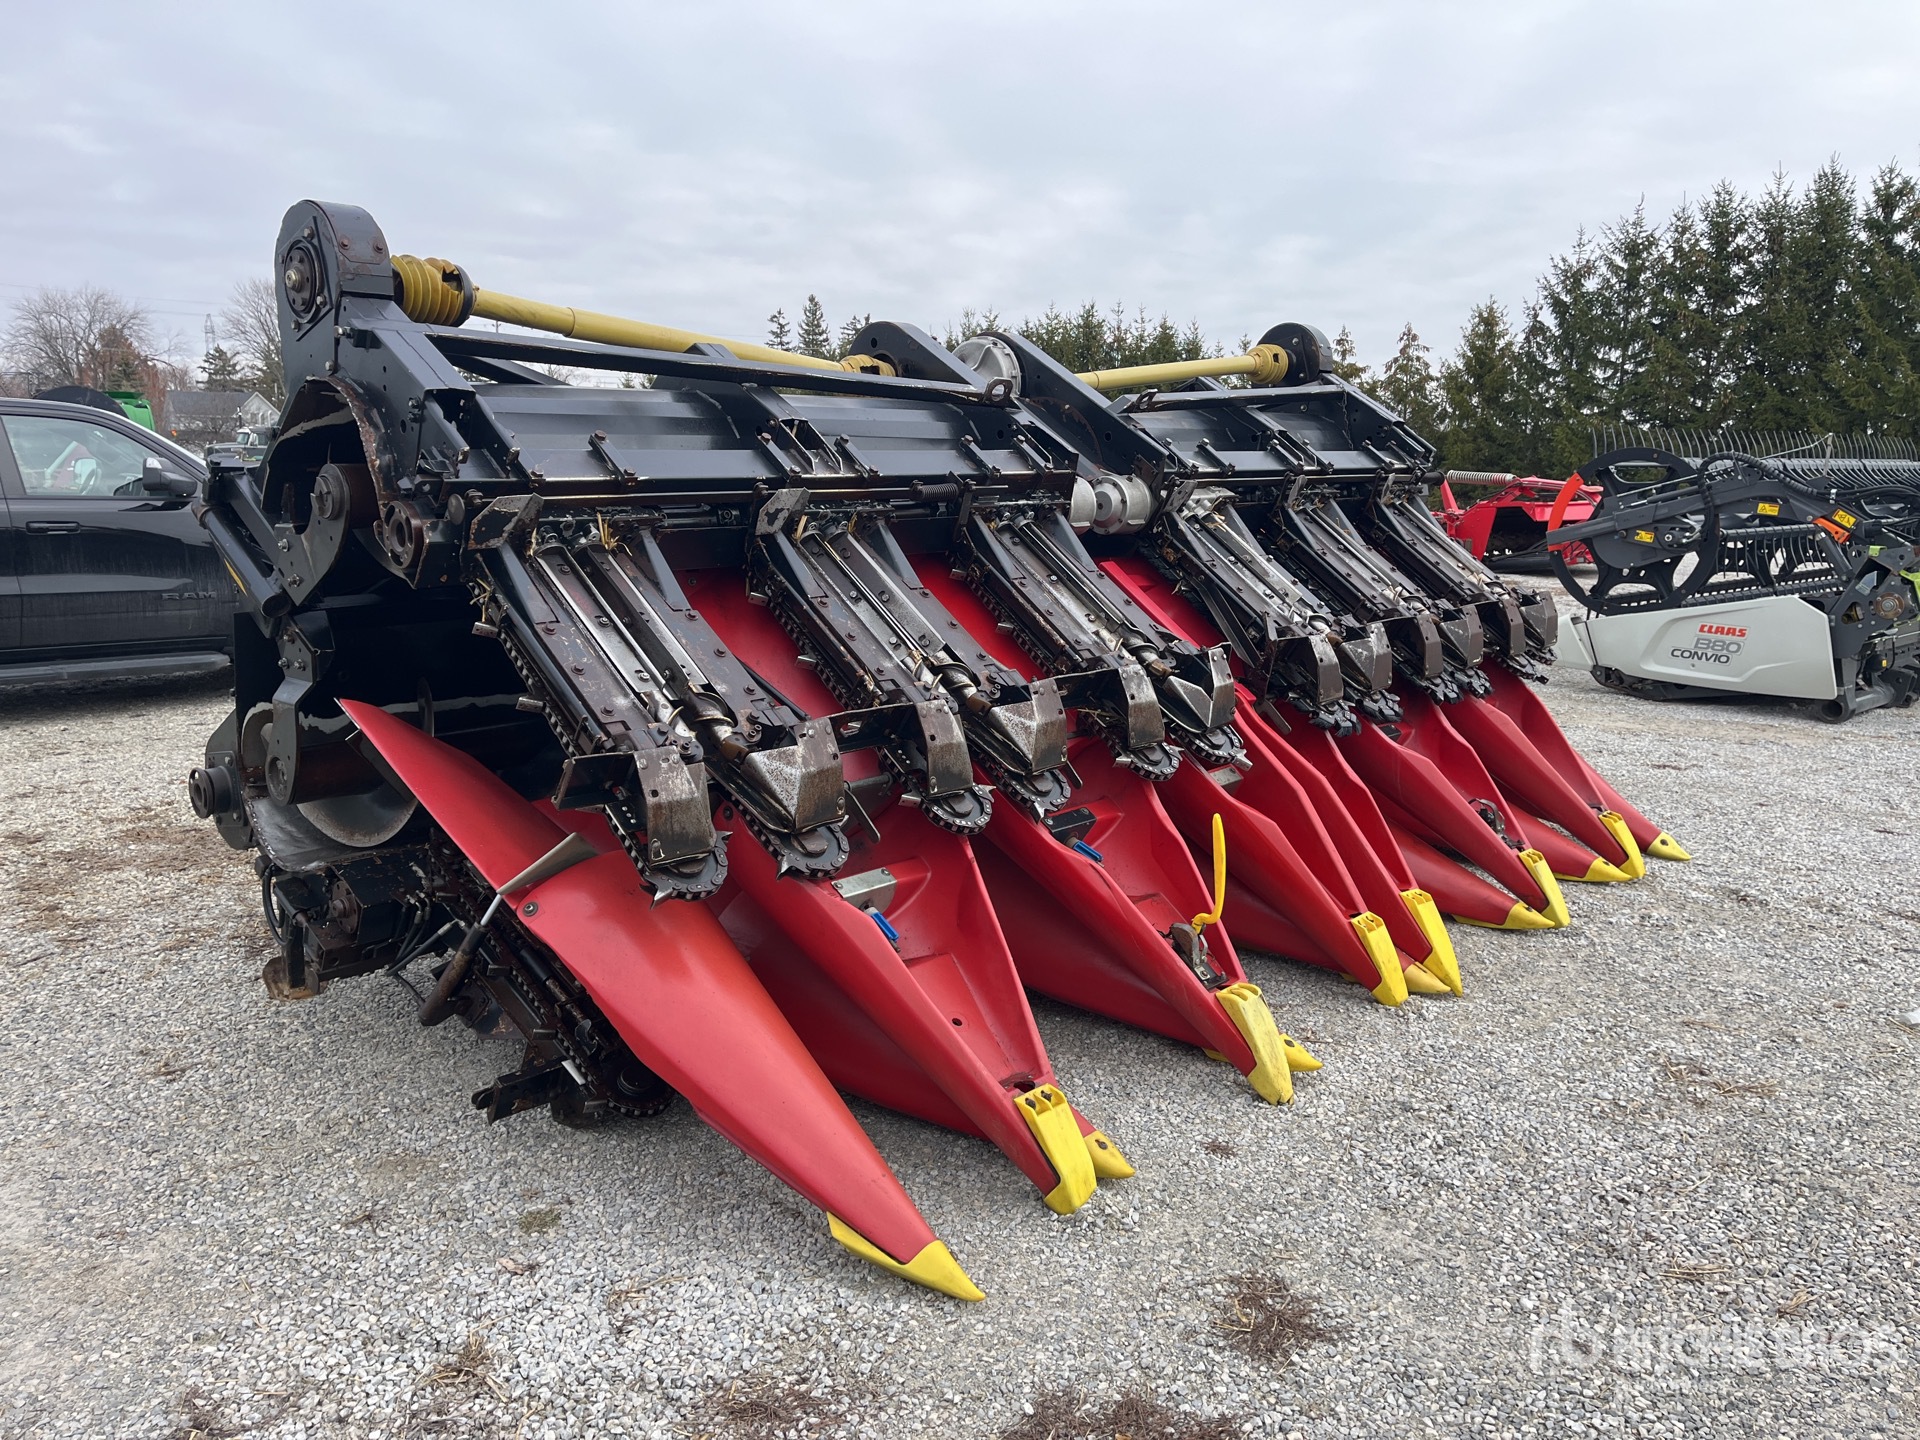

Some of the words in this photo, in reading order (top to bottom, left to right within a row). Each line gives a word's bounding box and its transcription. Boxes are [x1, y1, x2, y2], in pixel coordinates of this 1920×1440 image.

[161, 591, 217, 601] RAM
[1699, 624, 1747, 638] CLAAS
[1670, 648, 1730, 664] CONVIO
